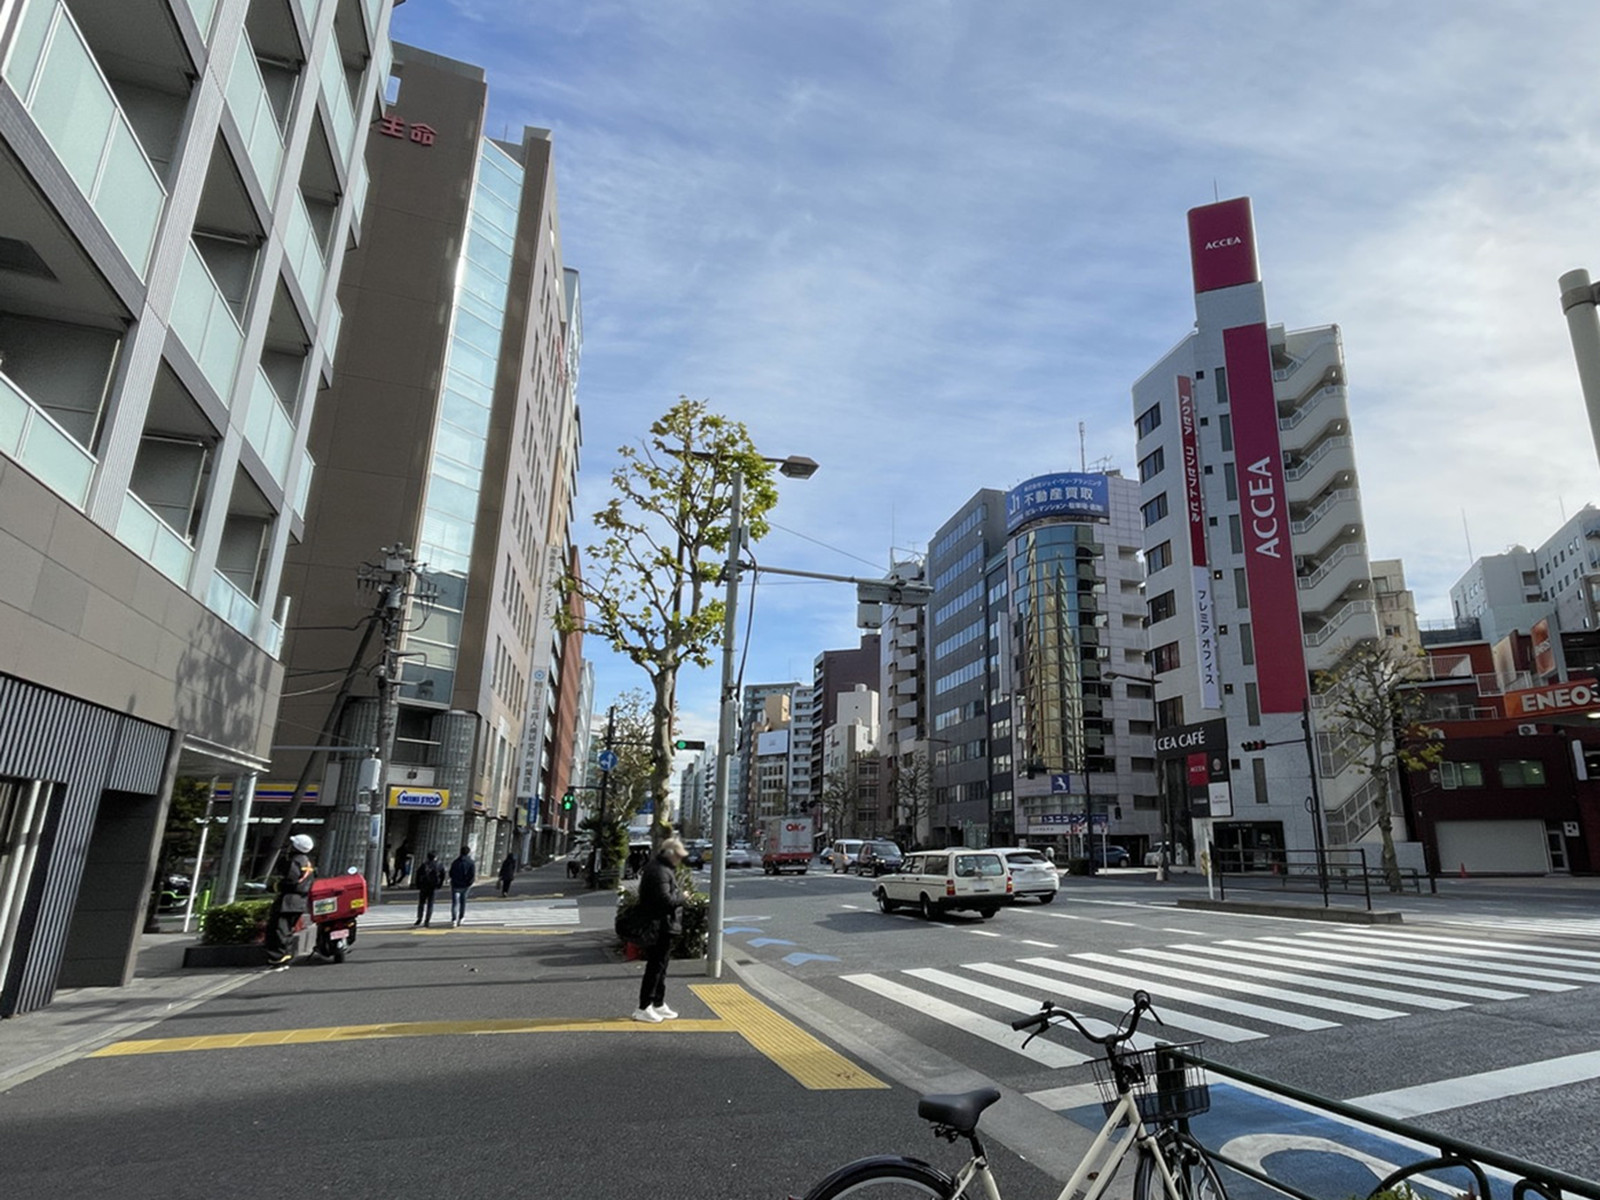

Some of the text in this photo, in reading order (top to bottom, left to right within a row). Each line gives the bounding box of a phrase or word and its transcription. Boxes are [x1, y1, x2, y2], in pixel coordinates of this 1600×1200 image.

[380, 112, 437, 146] 生命
[1205, 236, 1241, 250] ACCEA
[1024, 486, 1093, 506] 不動産買取
[1247, 456, 1280, 558] ACCEA
[1178, 726, 1205, 748] CAFÉ
